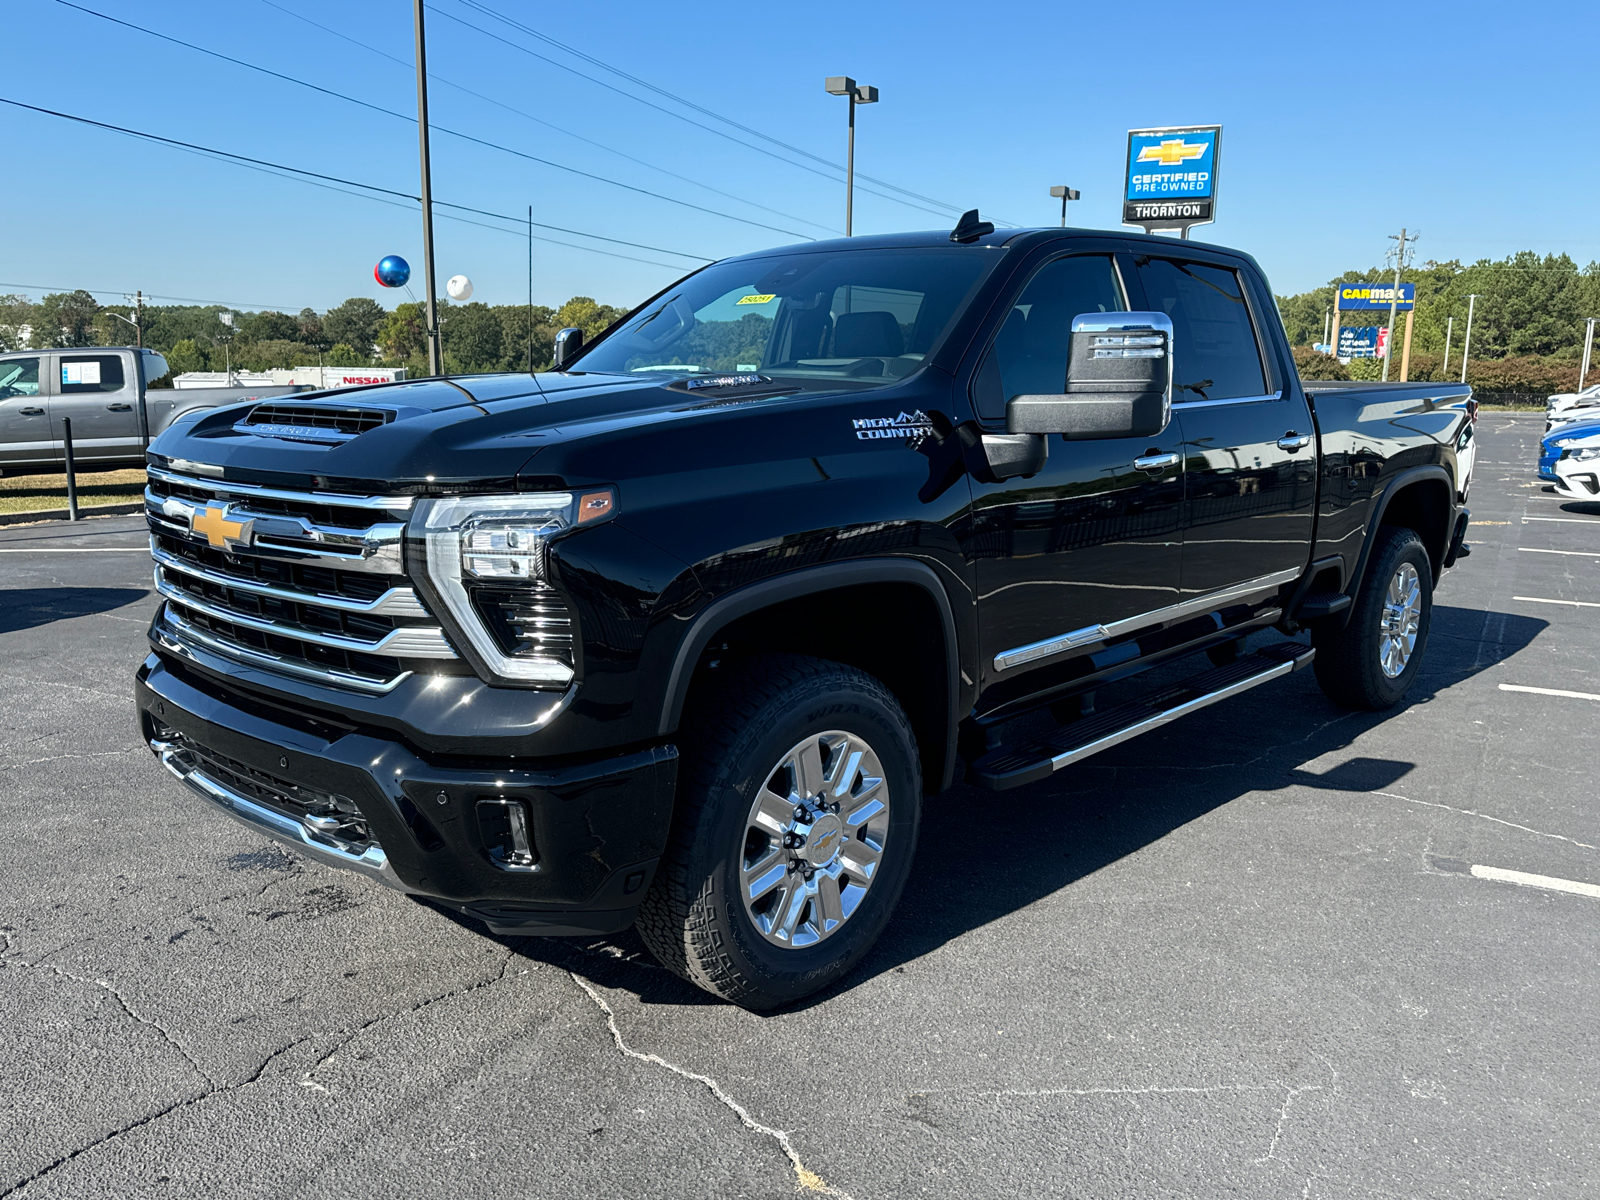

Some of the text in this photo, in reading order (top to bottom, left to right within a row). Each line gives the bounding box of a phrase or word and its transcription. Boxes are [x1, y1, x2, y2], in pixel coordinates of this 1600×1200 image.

[1132, 172, 1209, 184] CERTIFIED
[1135, 181, 1204, 192] PRE-OWNED
[1135, 205, 1201, 218] THORNTON
[342, 376, 390, 385] NISSAN
[852, 417, 895, 429] HIGH
[856, 426, 933, 440] COUNTRY
